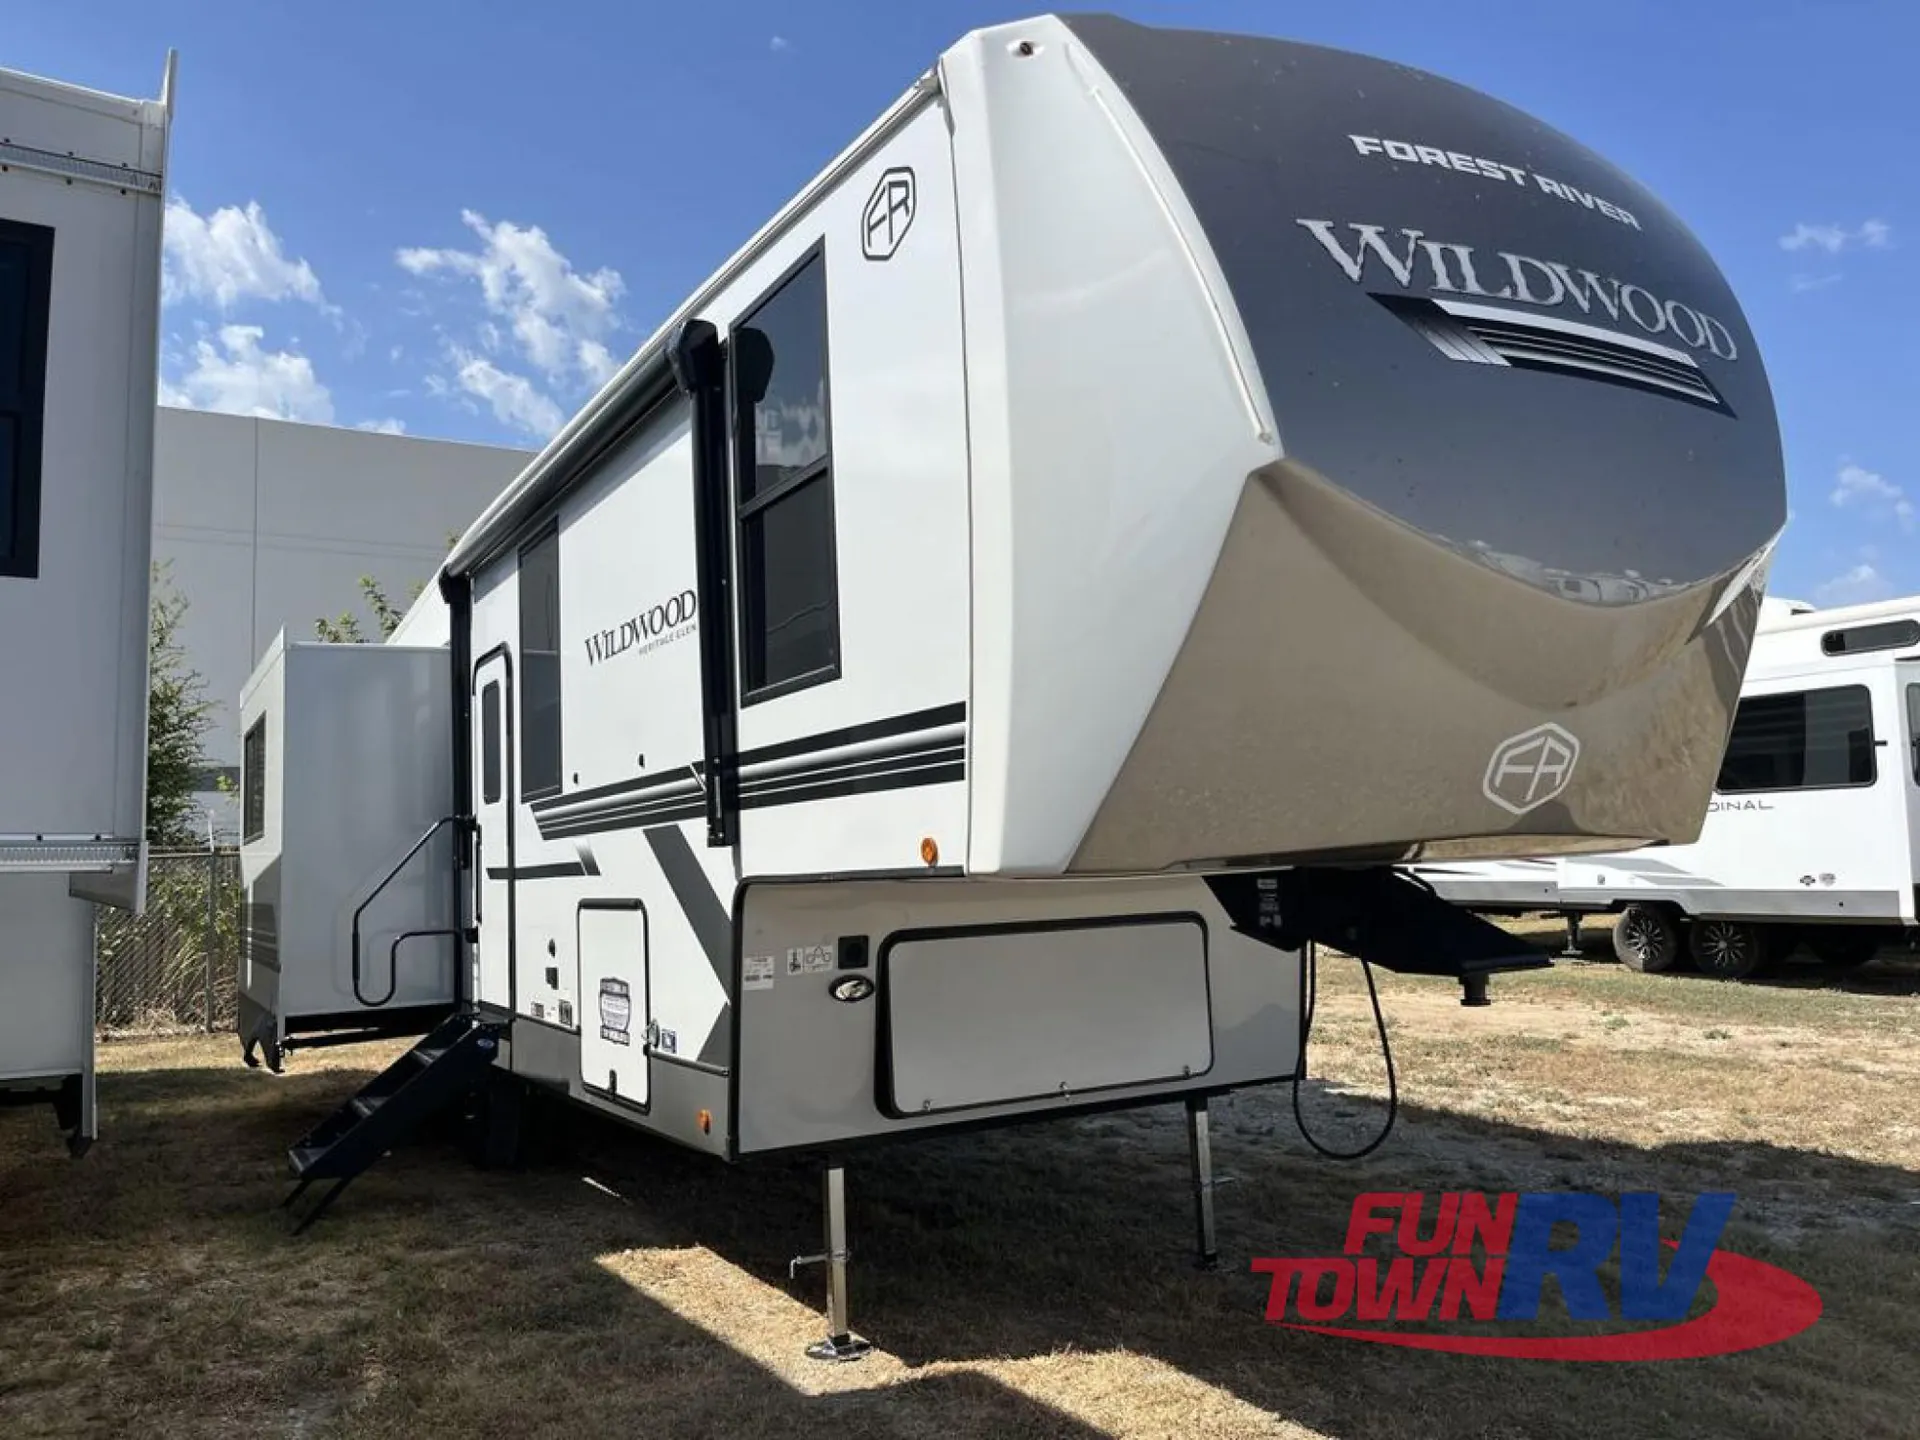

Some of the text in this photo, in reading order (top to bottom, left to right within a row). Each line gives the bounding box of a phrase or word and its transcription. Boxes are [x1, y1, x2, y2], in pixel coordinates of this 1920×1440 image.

[1348, 134, 1642, 231] FOREST RIVER
[1296, 217, 1739, 361] WILDWOOD
[584, 589, 697, 667] WILDWOOD
